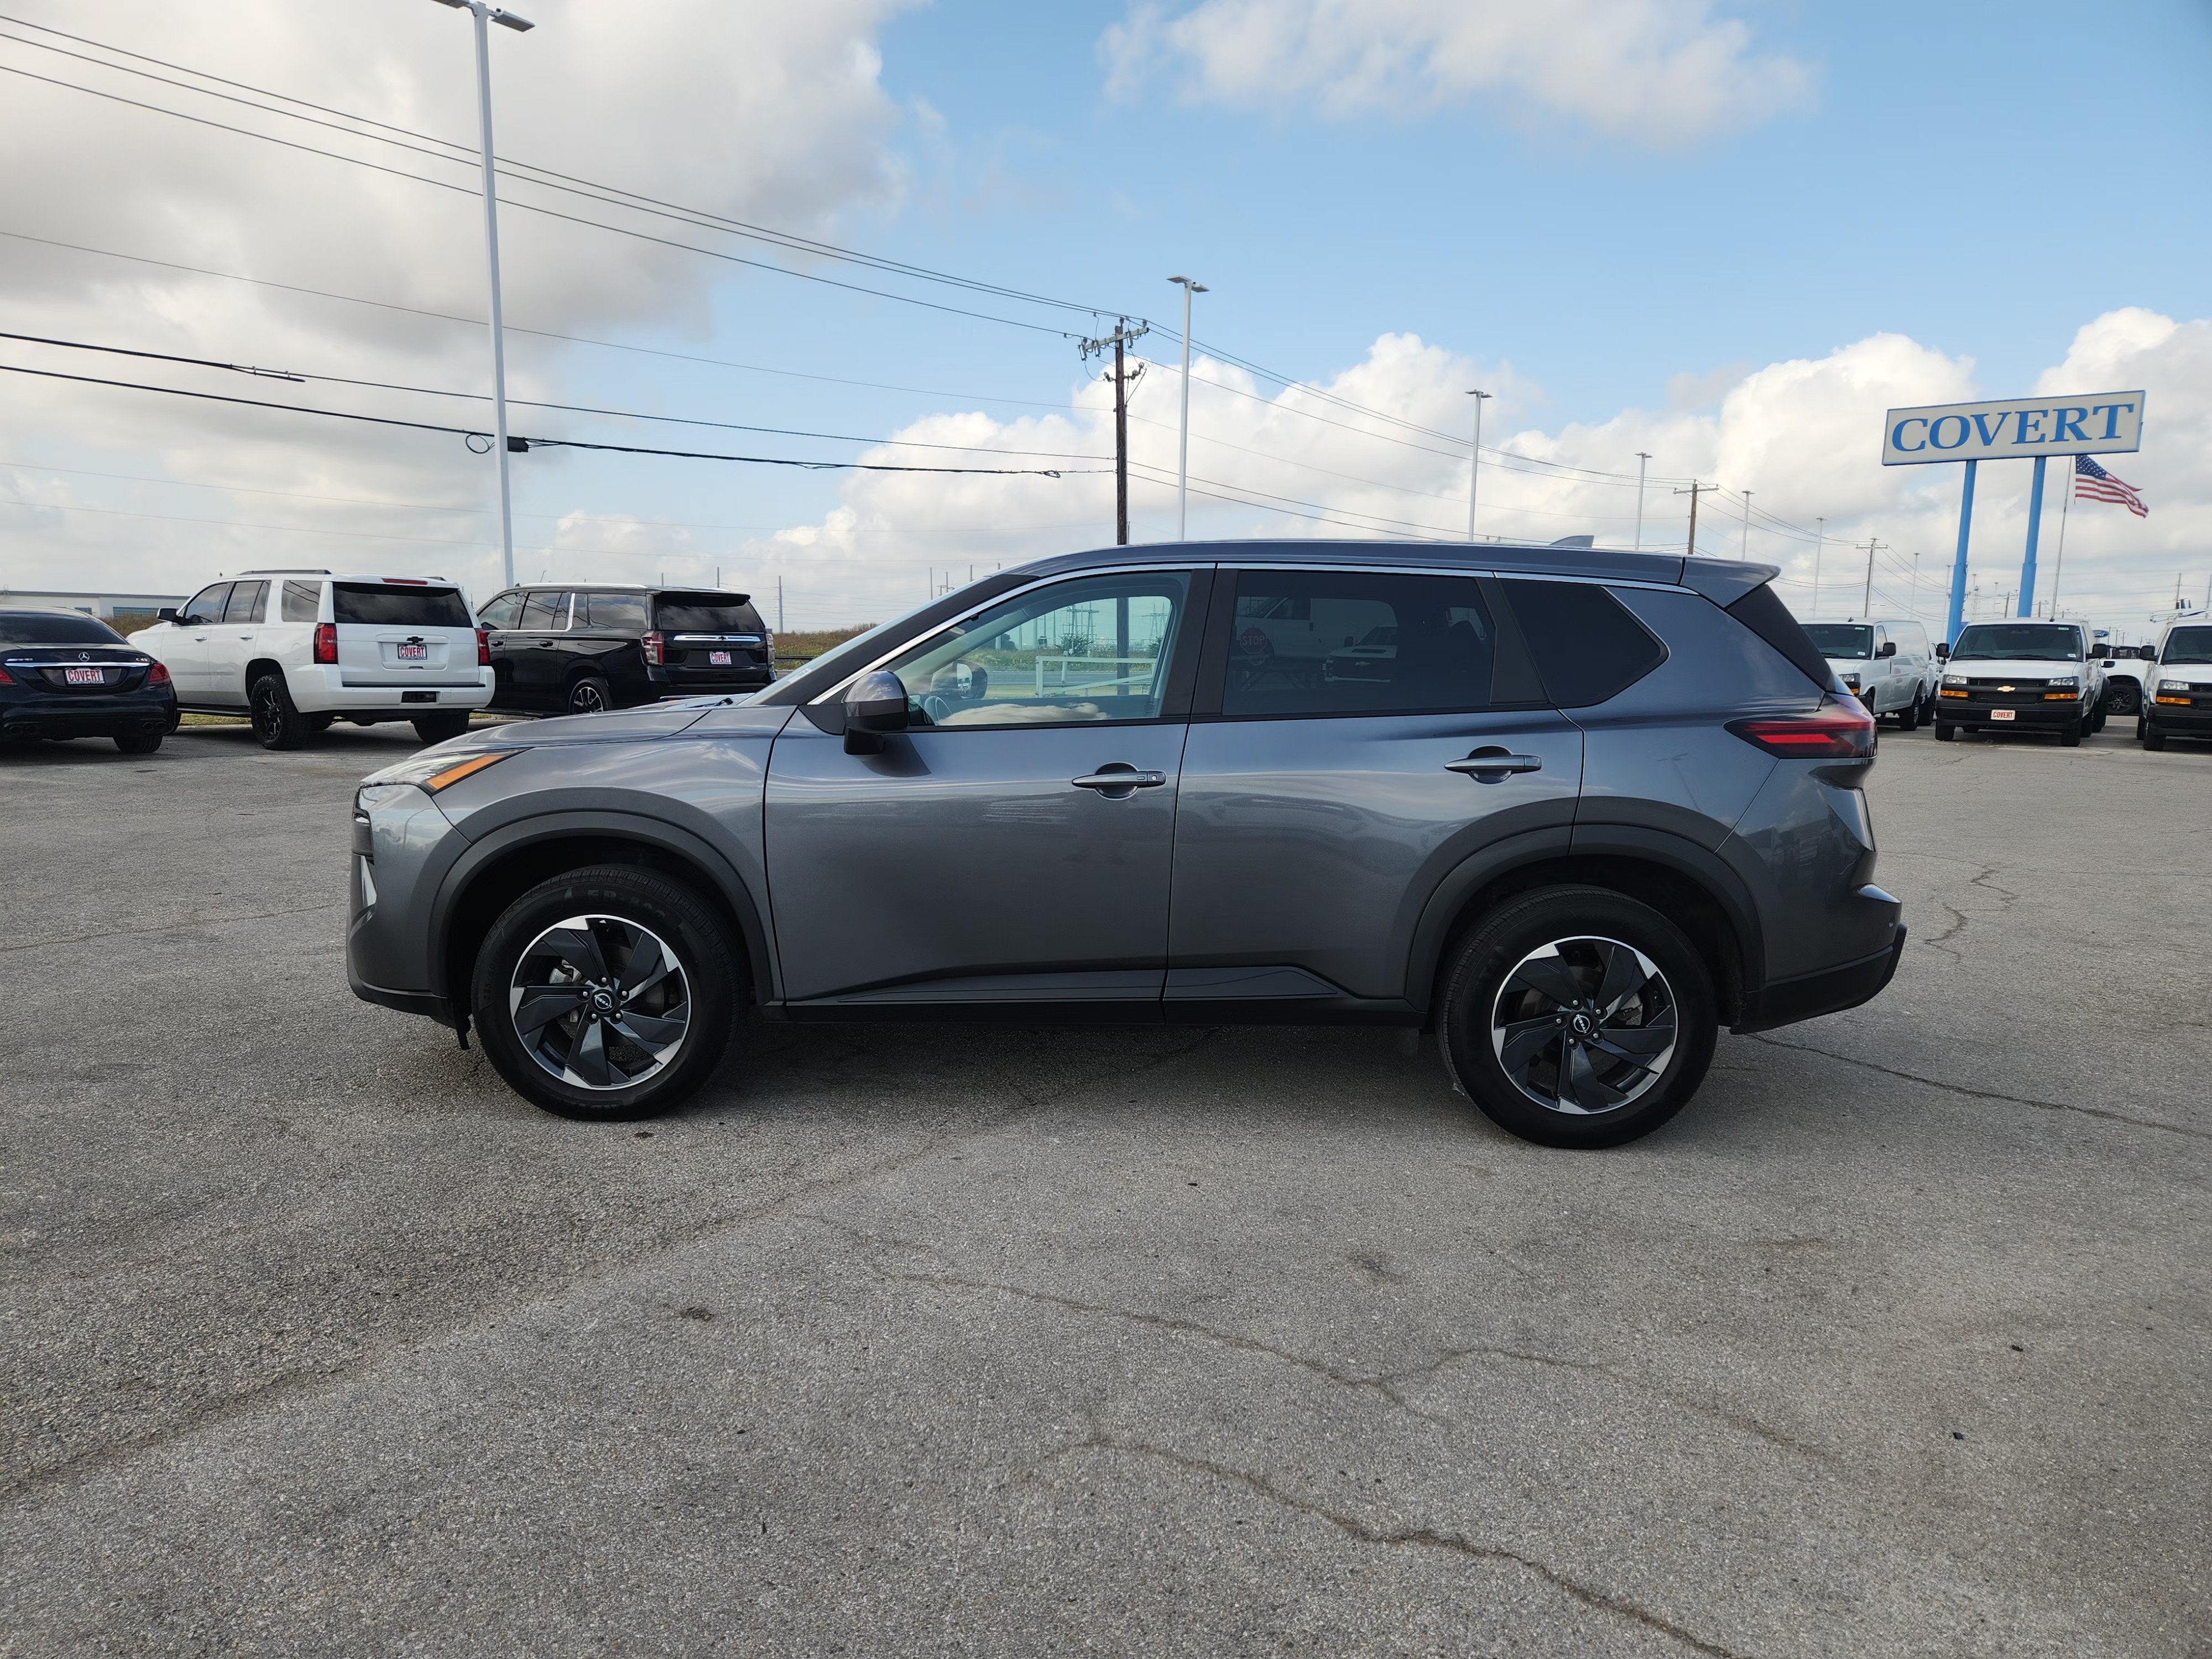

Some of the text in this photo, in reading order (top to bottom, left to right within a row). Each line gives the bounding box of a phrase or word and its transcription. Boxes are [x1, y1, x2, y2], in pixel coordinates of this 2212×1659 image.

[1892, 404, 2135, 452] COVERT
[1242, 636, 1265, 646] STOP
[400, 647, 425, 657] COVERT
[711, 654, 729, 663] COVERT
[67, 670, 101, 681] COVERT
